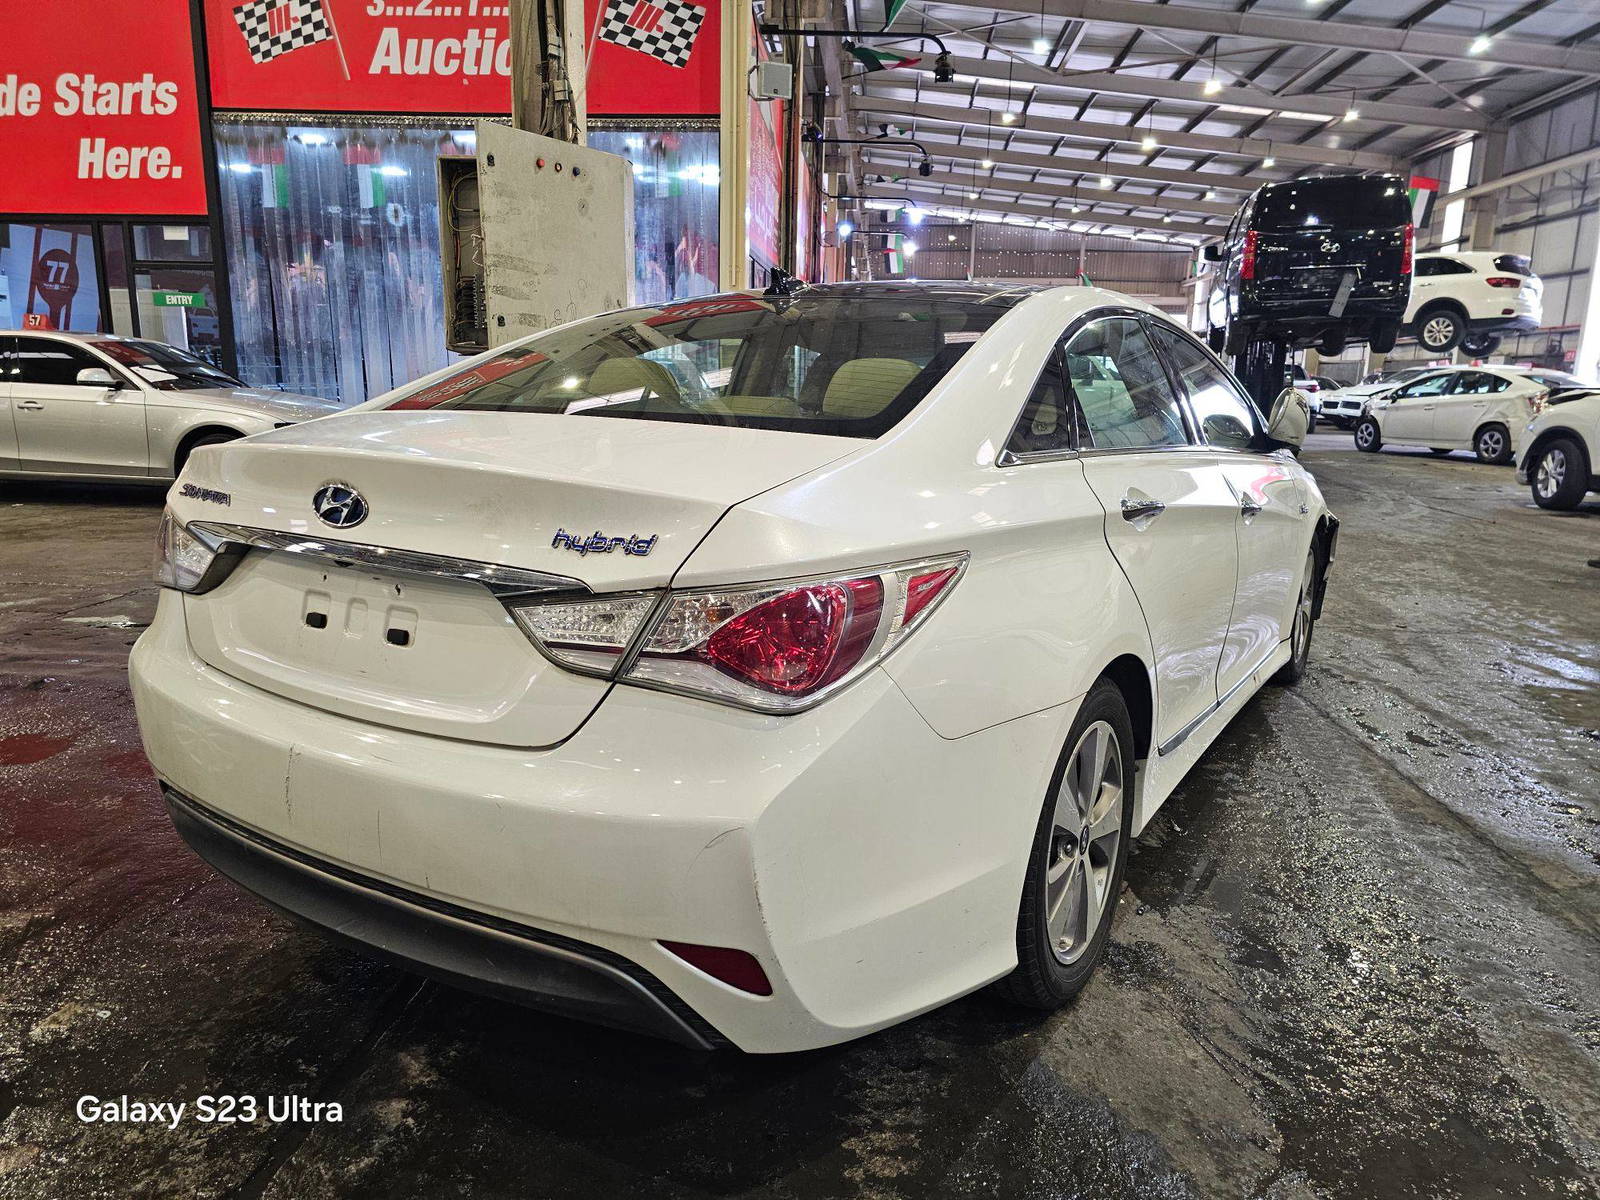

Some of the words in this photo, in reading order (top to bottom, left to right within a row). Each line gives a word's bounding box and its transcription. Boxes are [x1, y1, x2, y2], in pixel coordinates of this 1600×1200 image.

[53, 72, 179, 117] Starts
[77, 137, 183, 180] Here.
[46, 260, 70, 284] 77
[165, 294, 193, 306] ENTRY
[28, 314, 41, 327] 57
[551, 527, 659, 557] hybrid
